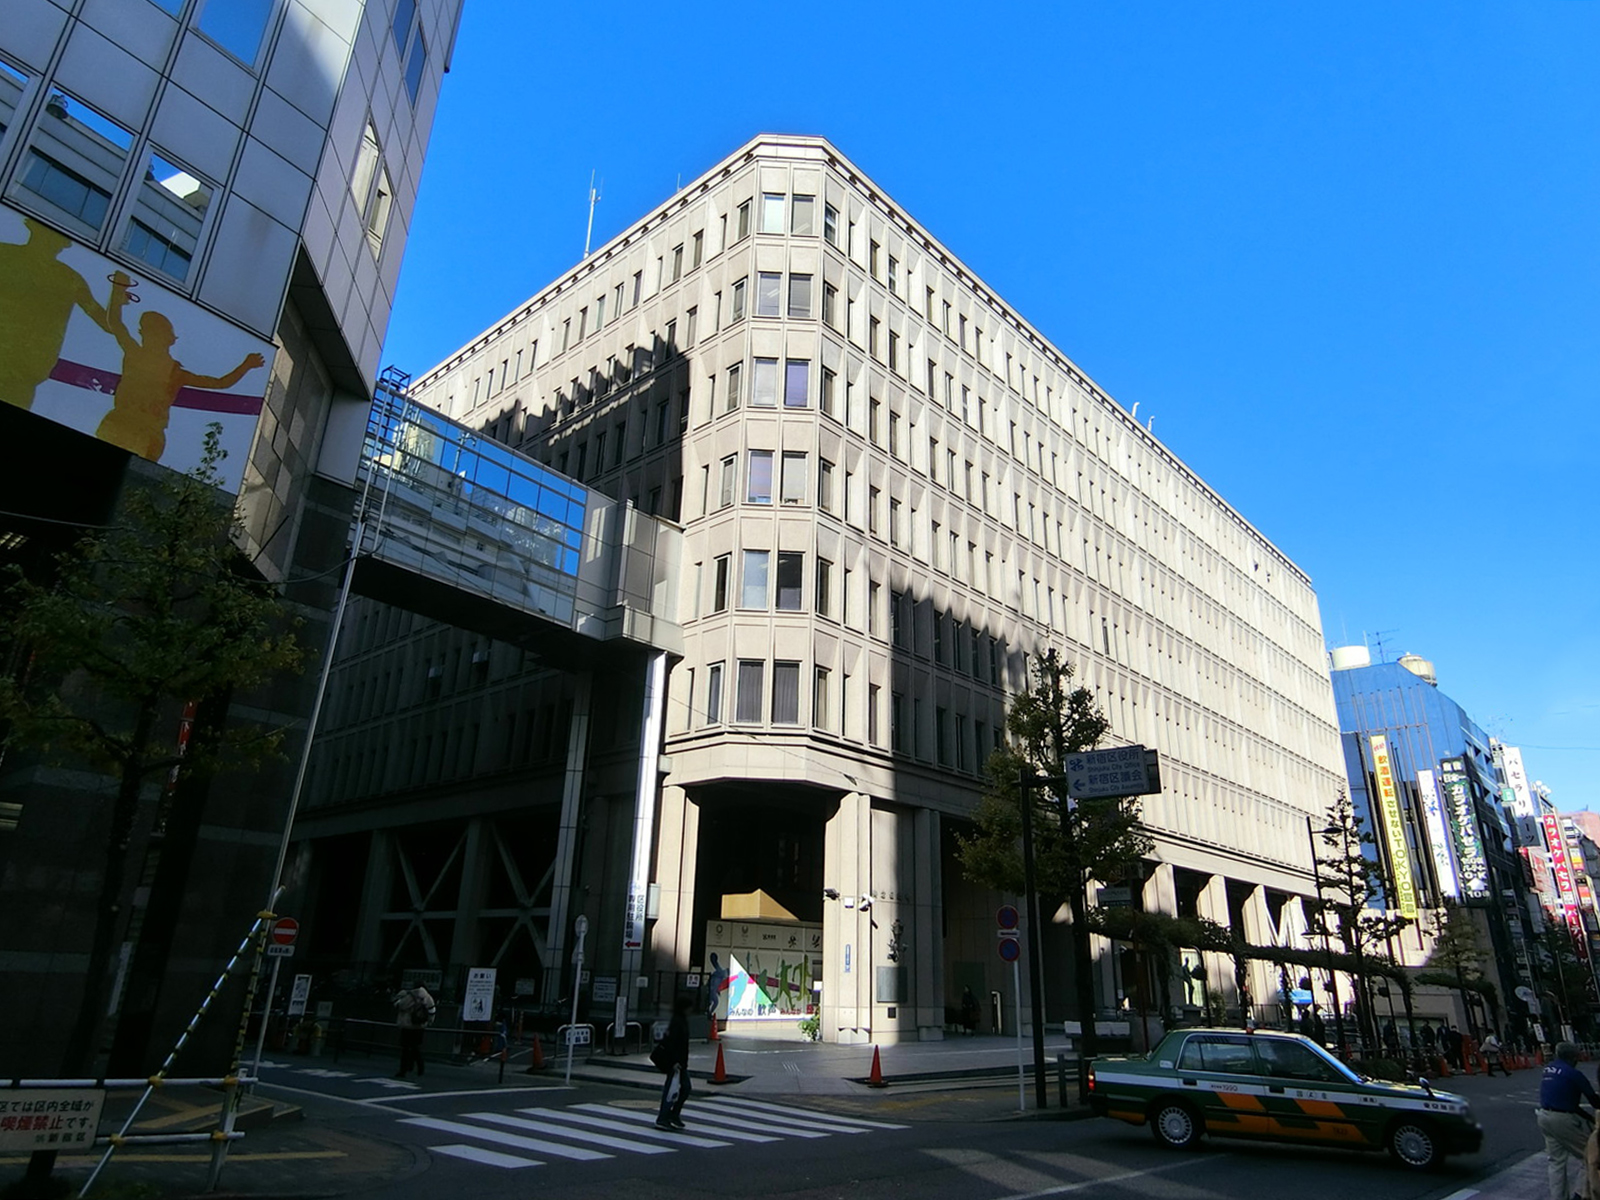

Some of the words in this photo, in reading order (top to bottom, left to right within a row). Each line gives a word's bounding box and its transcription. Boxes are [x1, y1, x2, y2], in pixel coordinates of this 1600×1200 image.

[1086, 749, 1140, 764] 新宿区役所
[1088, 769, 1142, 784] 新宿区議会
[1452, 784, 1476, 858] カラオケパセラ
[1508, 757, 1535, 845] パセラリゾーツ
[1545, 816, 1571, 891] カラオケパセラ
